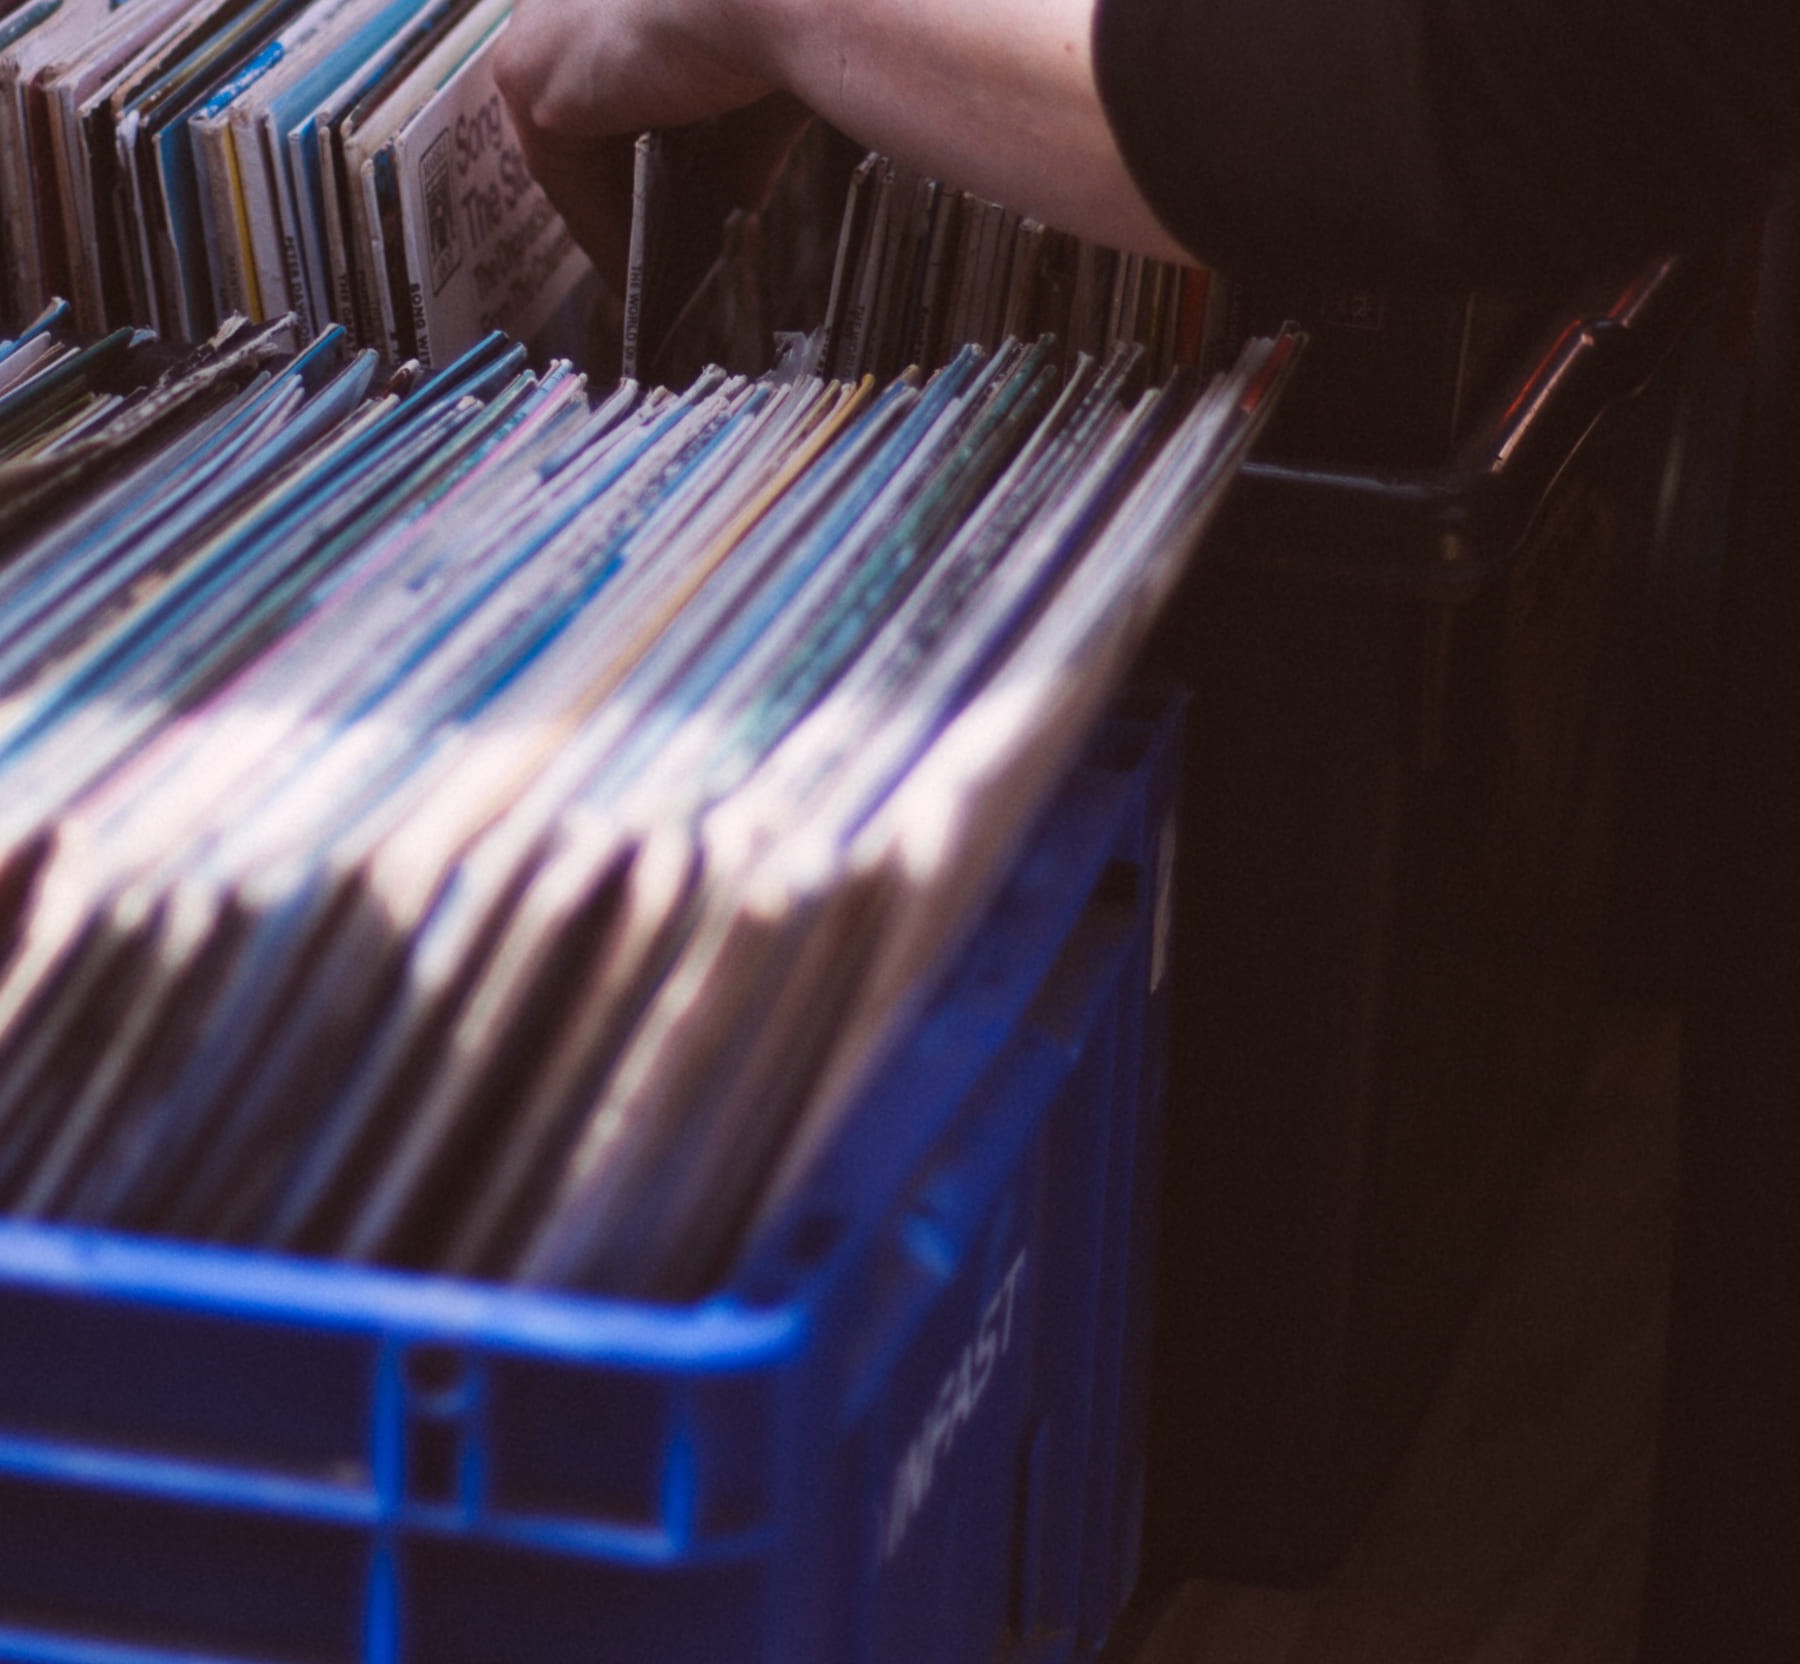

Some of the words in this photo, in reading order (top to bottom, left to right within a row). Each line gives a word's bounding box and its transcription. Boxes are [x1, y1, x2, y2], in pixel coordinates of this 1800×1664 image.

[285, 236, 301, 278] PETER
[630, 264, 642, 288] THE
[409, 282, 427, 330] SONG
[625, 293, 640, 341] WORLD
[417, 335, 432, 368] WIT
